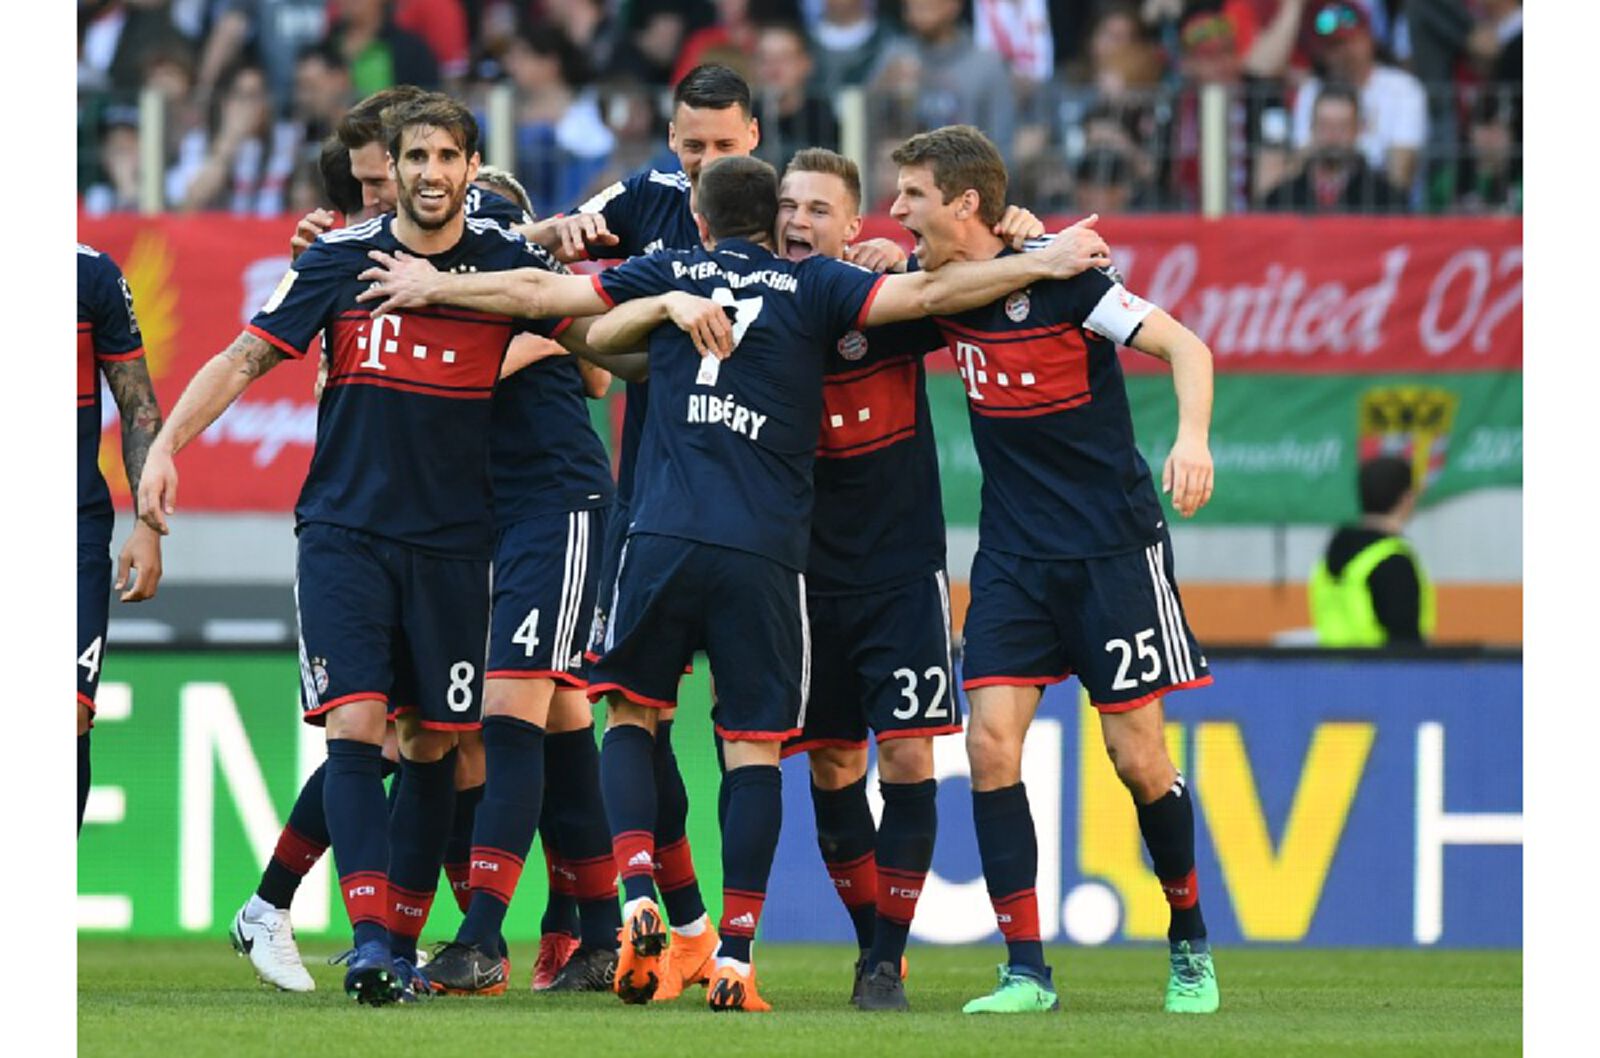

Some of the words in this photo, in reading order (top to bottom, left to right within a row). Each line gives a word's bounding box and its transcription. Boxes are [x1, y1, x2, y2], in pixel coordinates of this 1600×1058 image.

[694, 286, 764, 388] 7
[686, 393, 767, 441] RIBÉRY
[511, 607, 540, 657] 4
[77, 635, 102, 683] 4
[1105, 628, 1162, 690] 25
[446, 660, 475, 712] 8
[892, 665, 948, 720] 32
[349, 885, 376, 899] FCB
